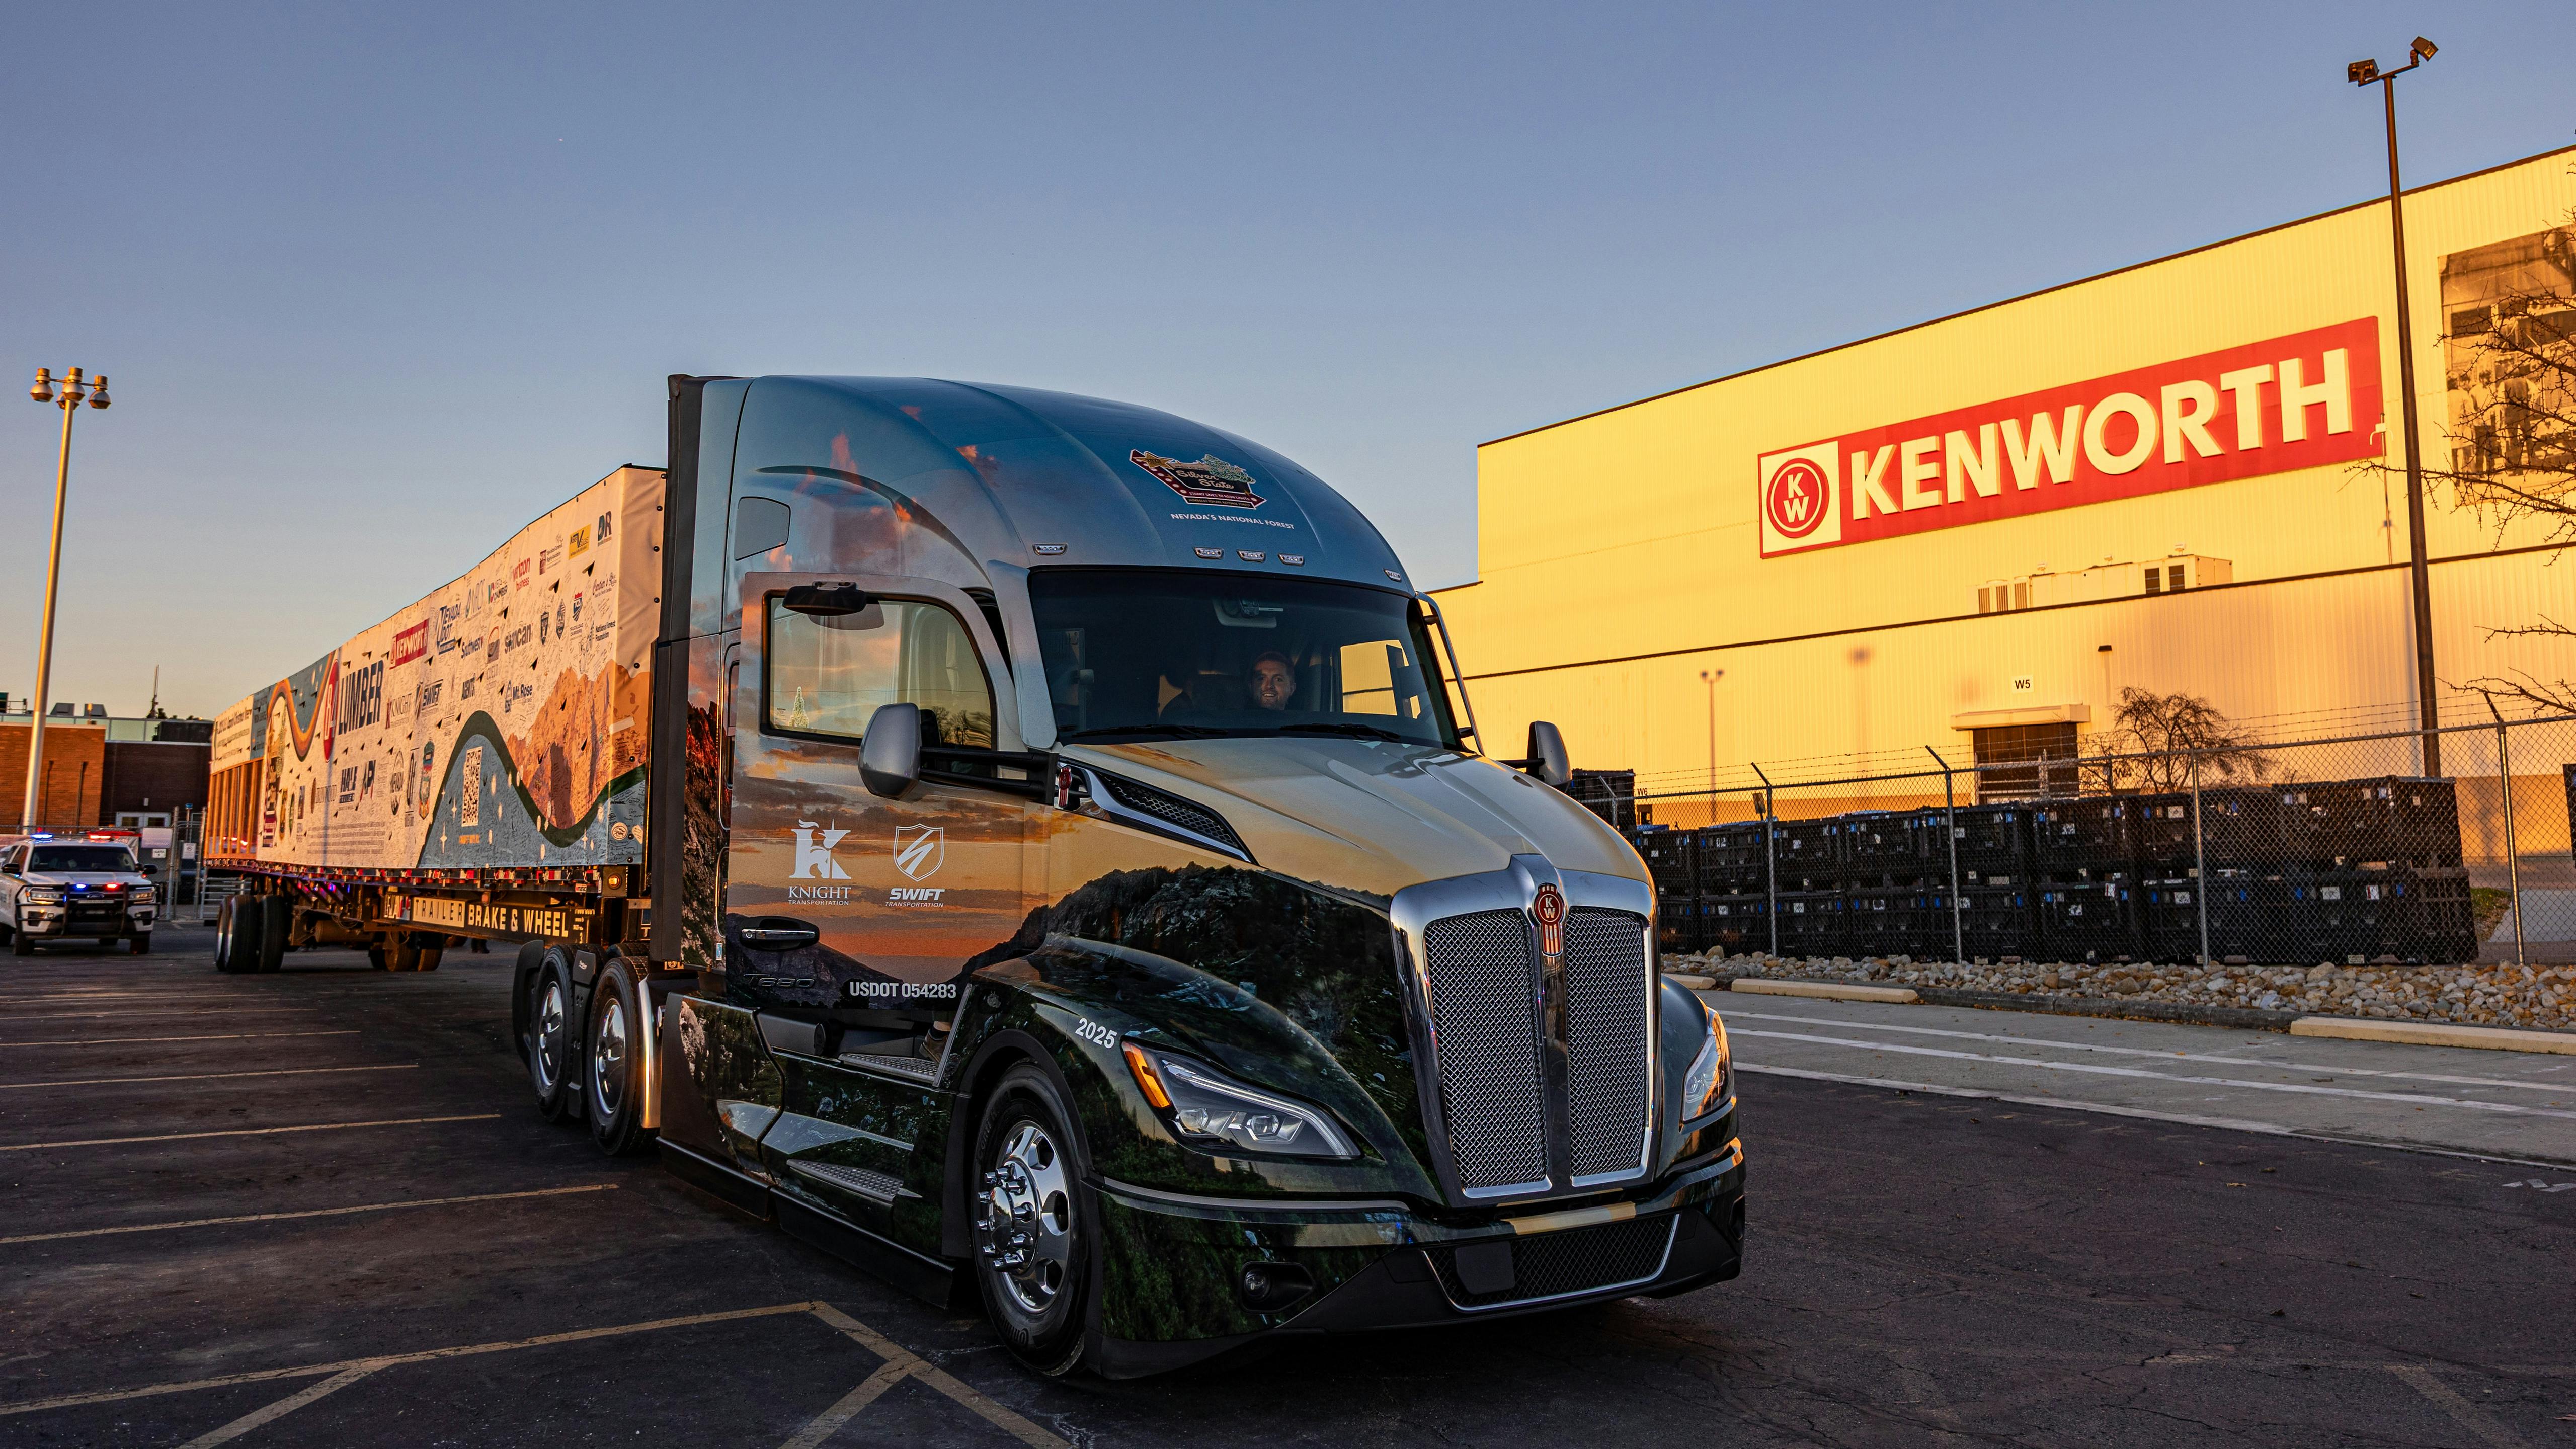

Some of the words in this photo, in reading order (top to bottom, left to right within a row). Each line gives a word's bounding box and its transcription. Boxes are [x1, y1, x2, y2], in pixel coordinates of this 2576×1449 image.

[1851, 347, 2354, 520] KENWORTH
[1176, 470, 1219, 480] Silver
[1199, 479, 1234, 490] State
[1788, 473, 1803, 498] K
[1784, 498, 1809, 522] W
[1171, 513, 1217, 521] NEVADA'S
[1218, 515, 1264, 525] NATIONAL
[1265, 520, 1295, 529] FOREST
[516, 577, 529, 592] business
[396, 627, 428, 660] KENWORTH
[521, 684, 533, 698] Rose
[2015, 679, 2031, 689] W5
[338, 660, 384, 735] LUMBER
[391, 693, 412, 717] KNIGHT
[1637, 788, 1648, 796] W6
[789, 886, 851, 899] KNIGHT
[889, 888, 945, 901] SWIFT
[1546, 898, 1552, 908] K
[416, 899, 462, 922] TRAILER
[468, 904, 506, 930] BRAKE
[511, 909, 518, 932] &
[524, 909, 569, 937] WHEEL
[1544, 908, 1555, 918] W
[744, 973, 815, 988] T680
[850, 982, 897, 997] USDOT
[902, 982, 956, 999] 054283
[1075, 1017, 1118, 1049] 2025
